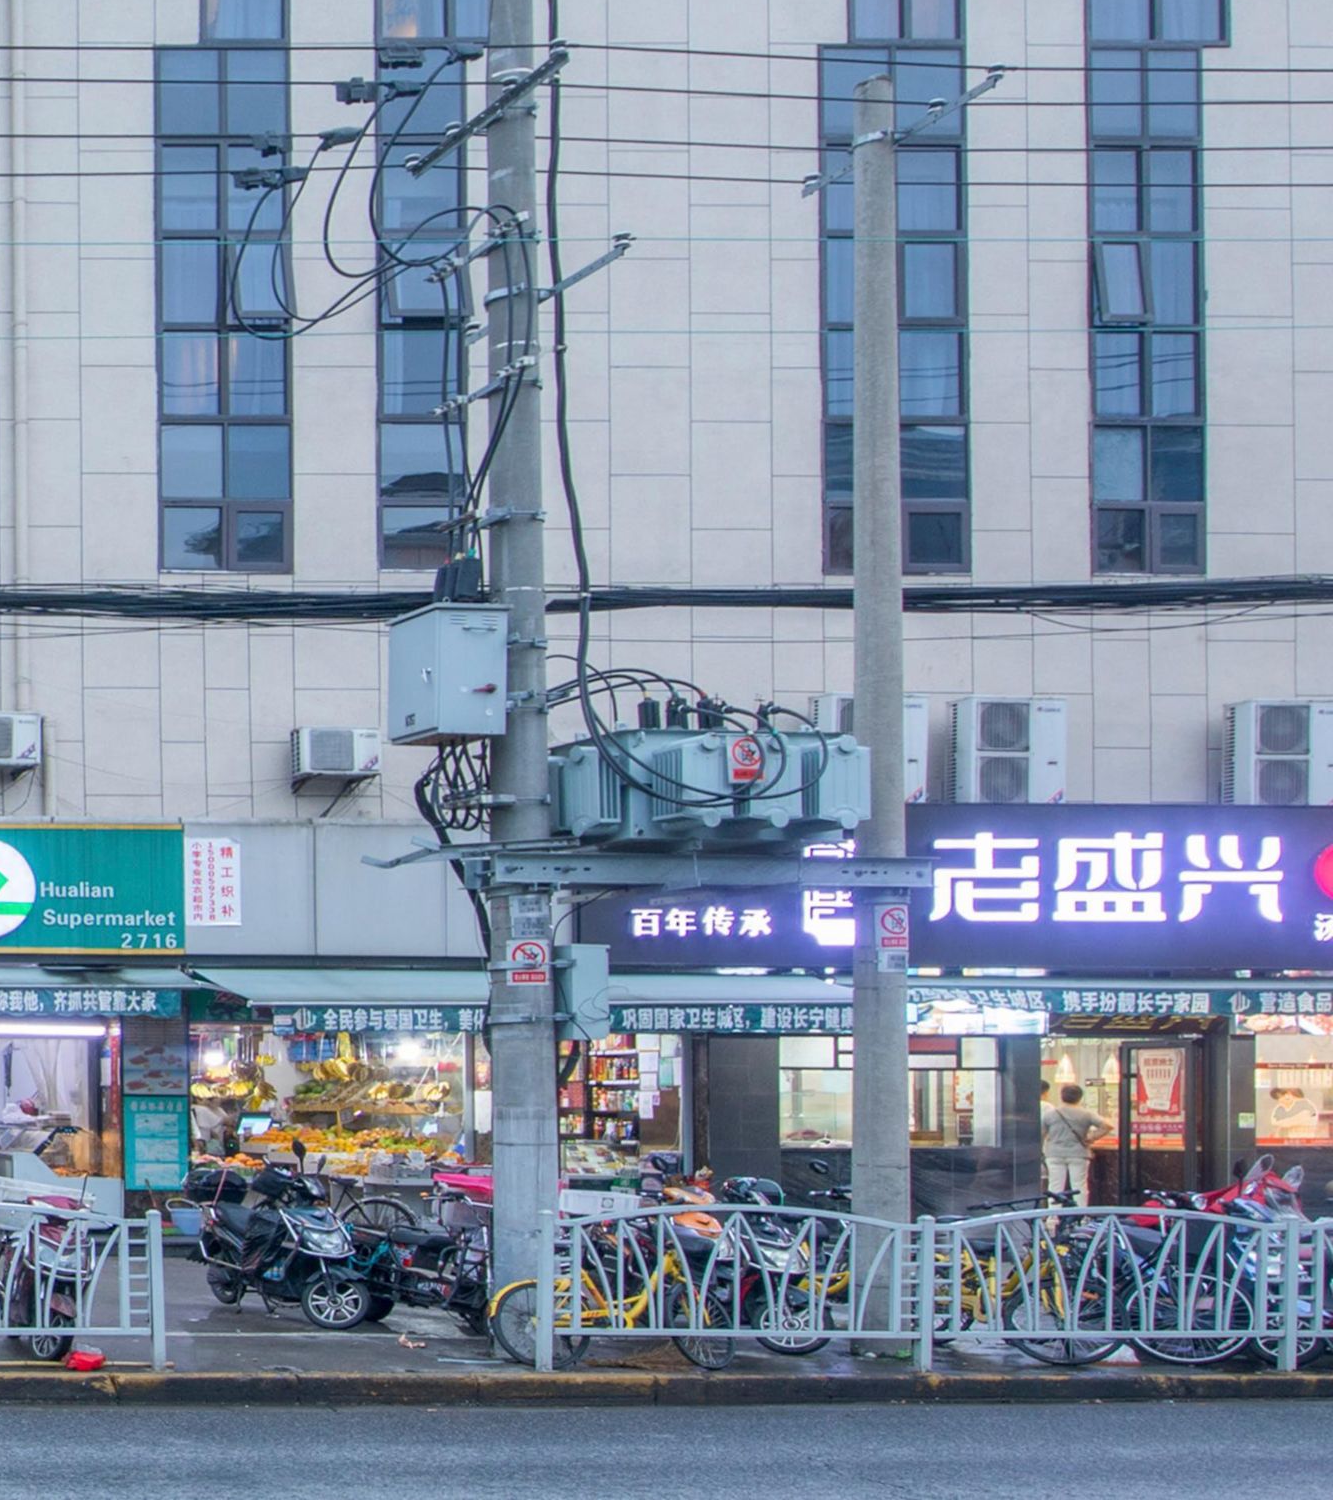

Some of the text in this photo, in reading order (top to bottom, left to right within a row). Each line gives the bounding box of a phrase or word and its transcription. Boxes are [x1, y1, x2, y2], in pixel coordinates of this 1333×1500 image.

[220, 846, 235, 917] 精工织补
[929, 831, 1284, 923] 老盛兴
[40, 881, 115, 899] Hualian
[42, 909, 177, 930] Supermarket
[631, 907, 772, 937] 百年传承
[120, 932, 179, 950] 2716
